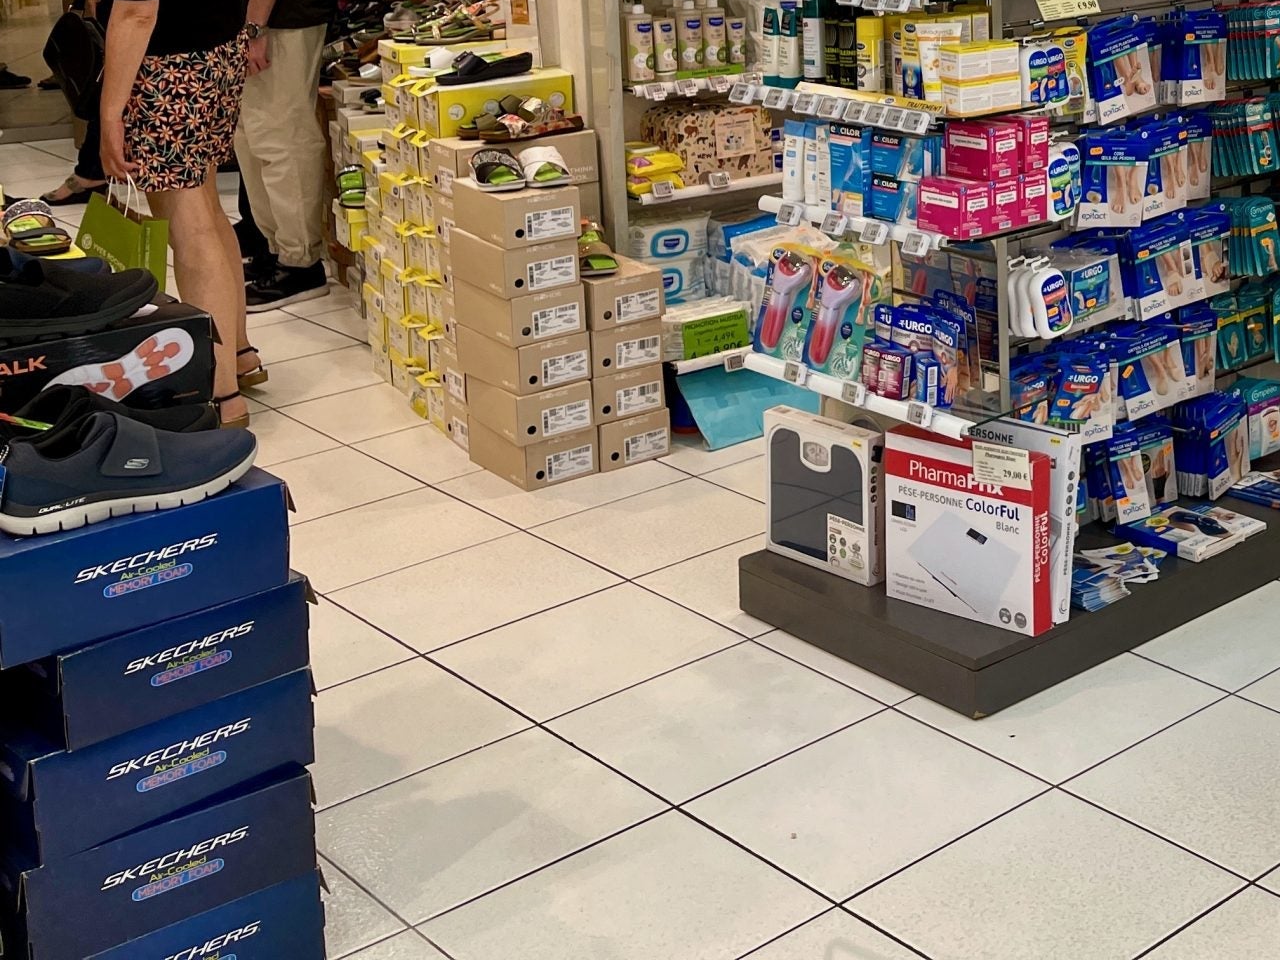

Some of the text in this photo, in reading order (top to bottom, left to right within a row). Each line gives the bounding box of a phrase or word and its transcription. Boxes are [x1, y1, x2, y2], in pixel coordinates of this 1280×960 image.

[905, 320, 933, 335] URGO
[1073, 374, 1099, 385] URGO
[898, 485, 1020, 522] PÈSE-PERSONNE ColorFul
[995, 521, 1020, 535] Blanc
[1040, 511, 1049, 566] ColorFul
[74, 533, 218, 584] SKECHERS
[120, 558, 176, 581] Air-Cooled
[108, 565, 188, 596] MEMORY FOAM
[124, 620, 255, 675] SKECHERS
[166, 647, 217, 670] Air-Cooled
[155, 652, 228, 684] MEMORY FOAM
[106, 718, 250, 780] SKECHERS
[153, 746, 210, 773] Air-Cooled
[142, 753, 222, 788] MEMORY FOAM
[101, 825, 249, 891] SKECHERS
[149, 855, 207, 882] Air-Cooled
[138, 861, 219, 898] MEMORY FOAM
